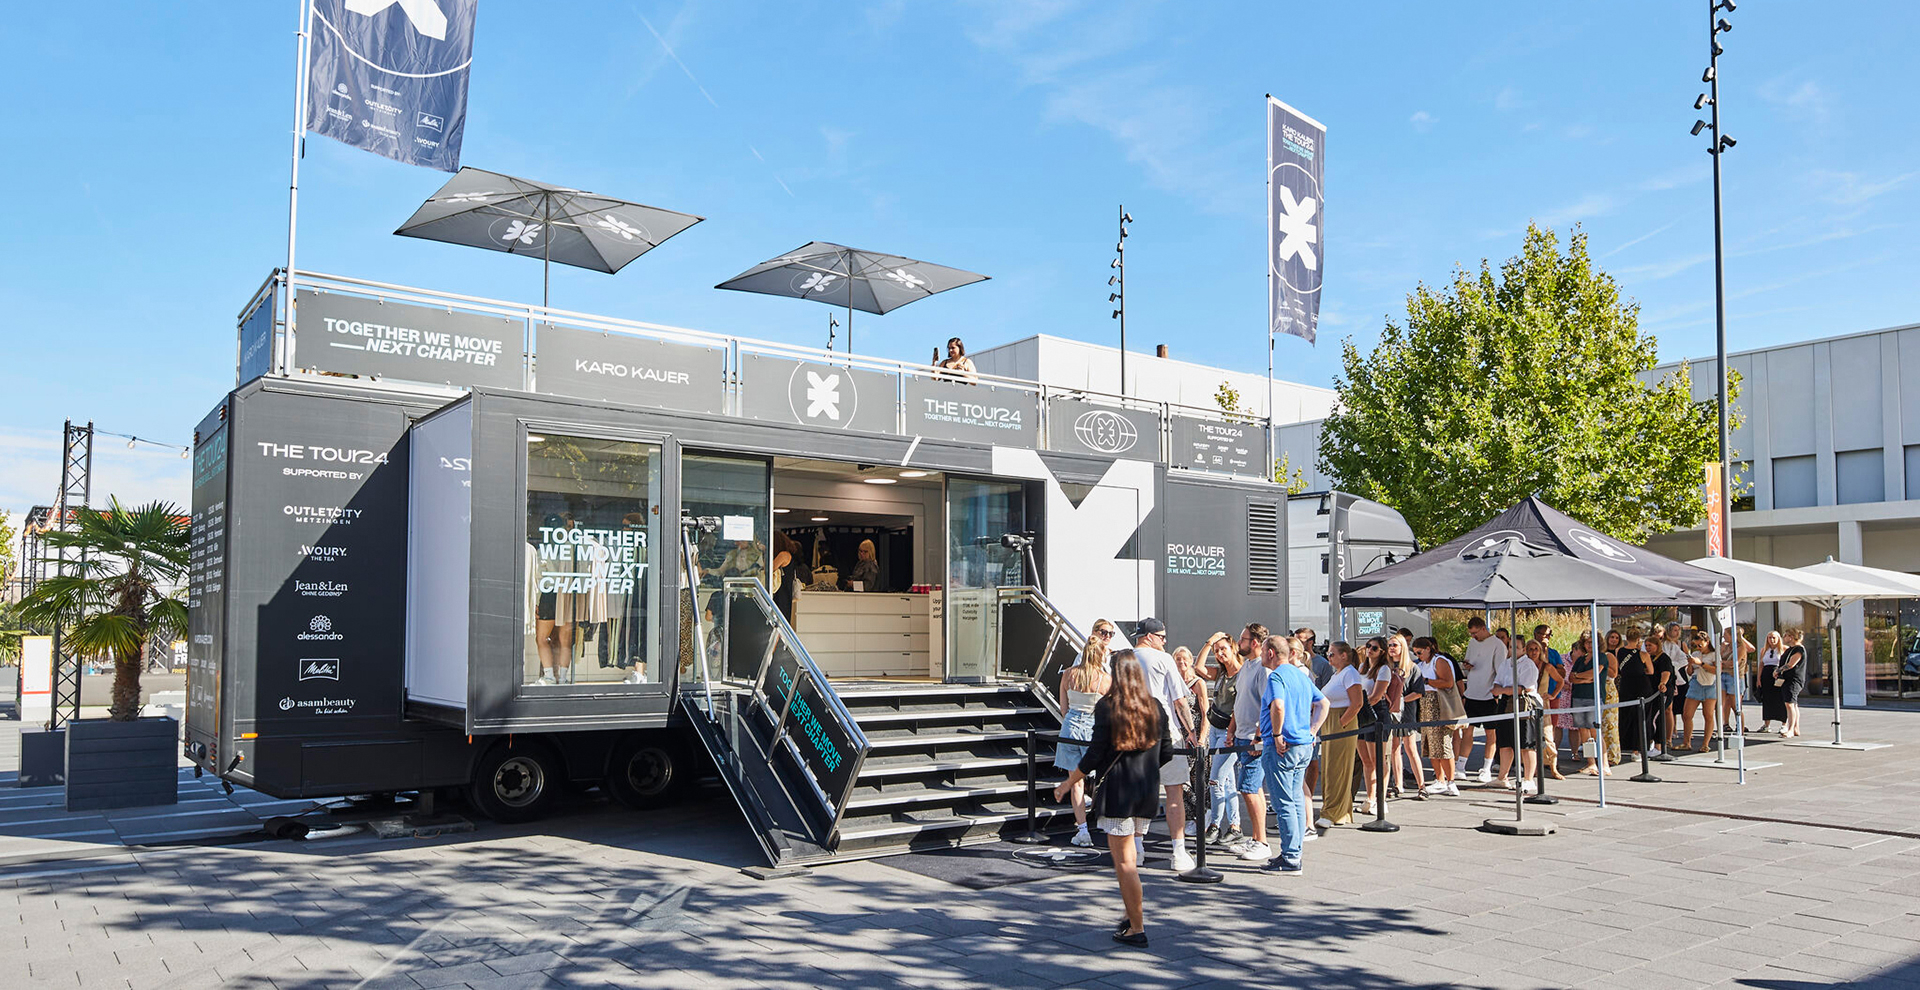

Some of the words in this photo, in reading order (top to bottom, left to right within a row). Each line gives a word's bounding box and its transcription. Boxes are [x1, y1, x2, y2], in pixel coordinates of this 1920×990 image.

[323, 317, 420, 343] TOGETHER
[423, 331, 451, 346] WE
[454, 335, 502, 354] MOVE
[417, 344, 497, 367] CHAPTER
[575, 359, 628, 377] KARO
[631, 366, 690, 385] KAUER
[924, 398, 958, 416] THE
[924, 413, 952, 422] TOGETHER
[962, 417, 977, 425] MOVE
[998, 422, 1022, 430] CHAPTER
[1198, 424, 1214, 434] THE
[257, 442, 304, 459] THE
[283, 467, 347, 479] SUPPORTED
[349, 472, 363, 480] BY
[295, 517, 351, 525] METZINGEN
[539, 527, 647, 547] TOGETHER
[539, 543, 572, 560] WE
[577, 545, 634, 562] MOVE
[1186, 545, 1225, 557] KAUER
[1337, 530, 1345, 590] AUER
[594, 562, 649, 579] NEXT
[295, 580, 348, 592] Jean&Len
[539, 576, 635, 594] CHAPTER
[297, 631, 343, 640] alessandro
[1359, 626, 1381, 634] CHAPTER
[297, 697, 356, 709] asambeauty
[780, 666, 811, 719] TOGTHER
[810, 715, 822, 735] WE
[821, 734, 842, 767] MOVE
[804, 723, 836, 773] CHAPTER
